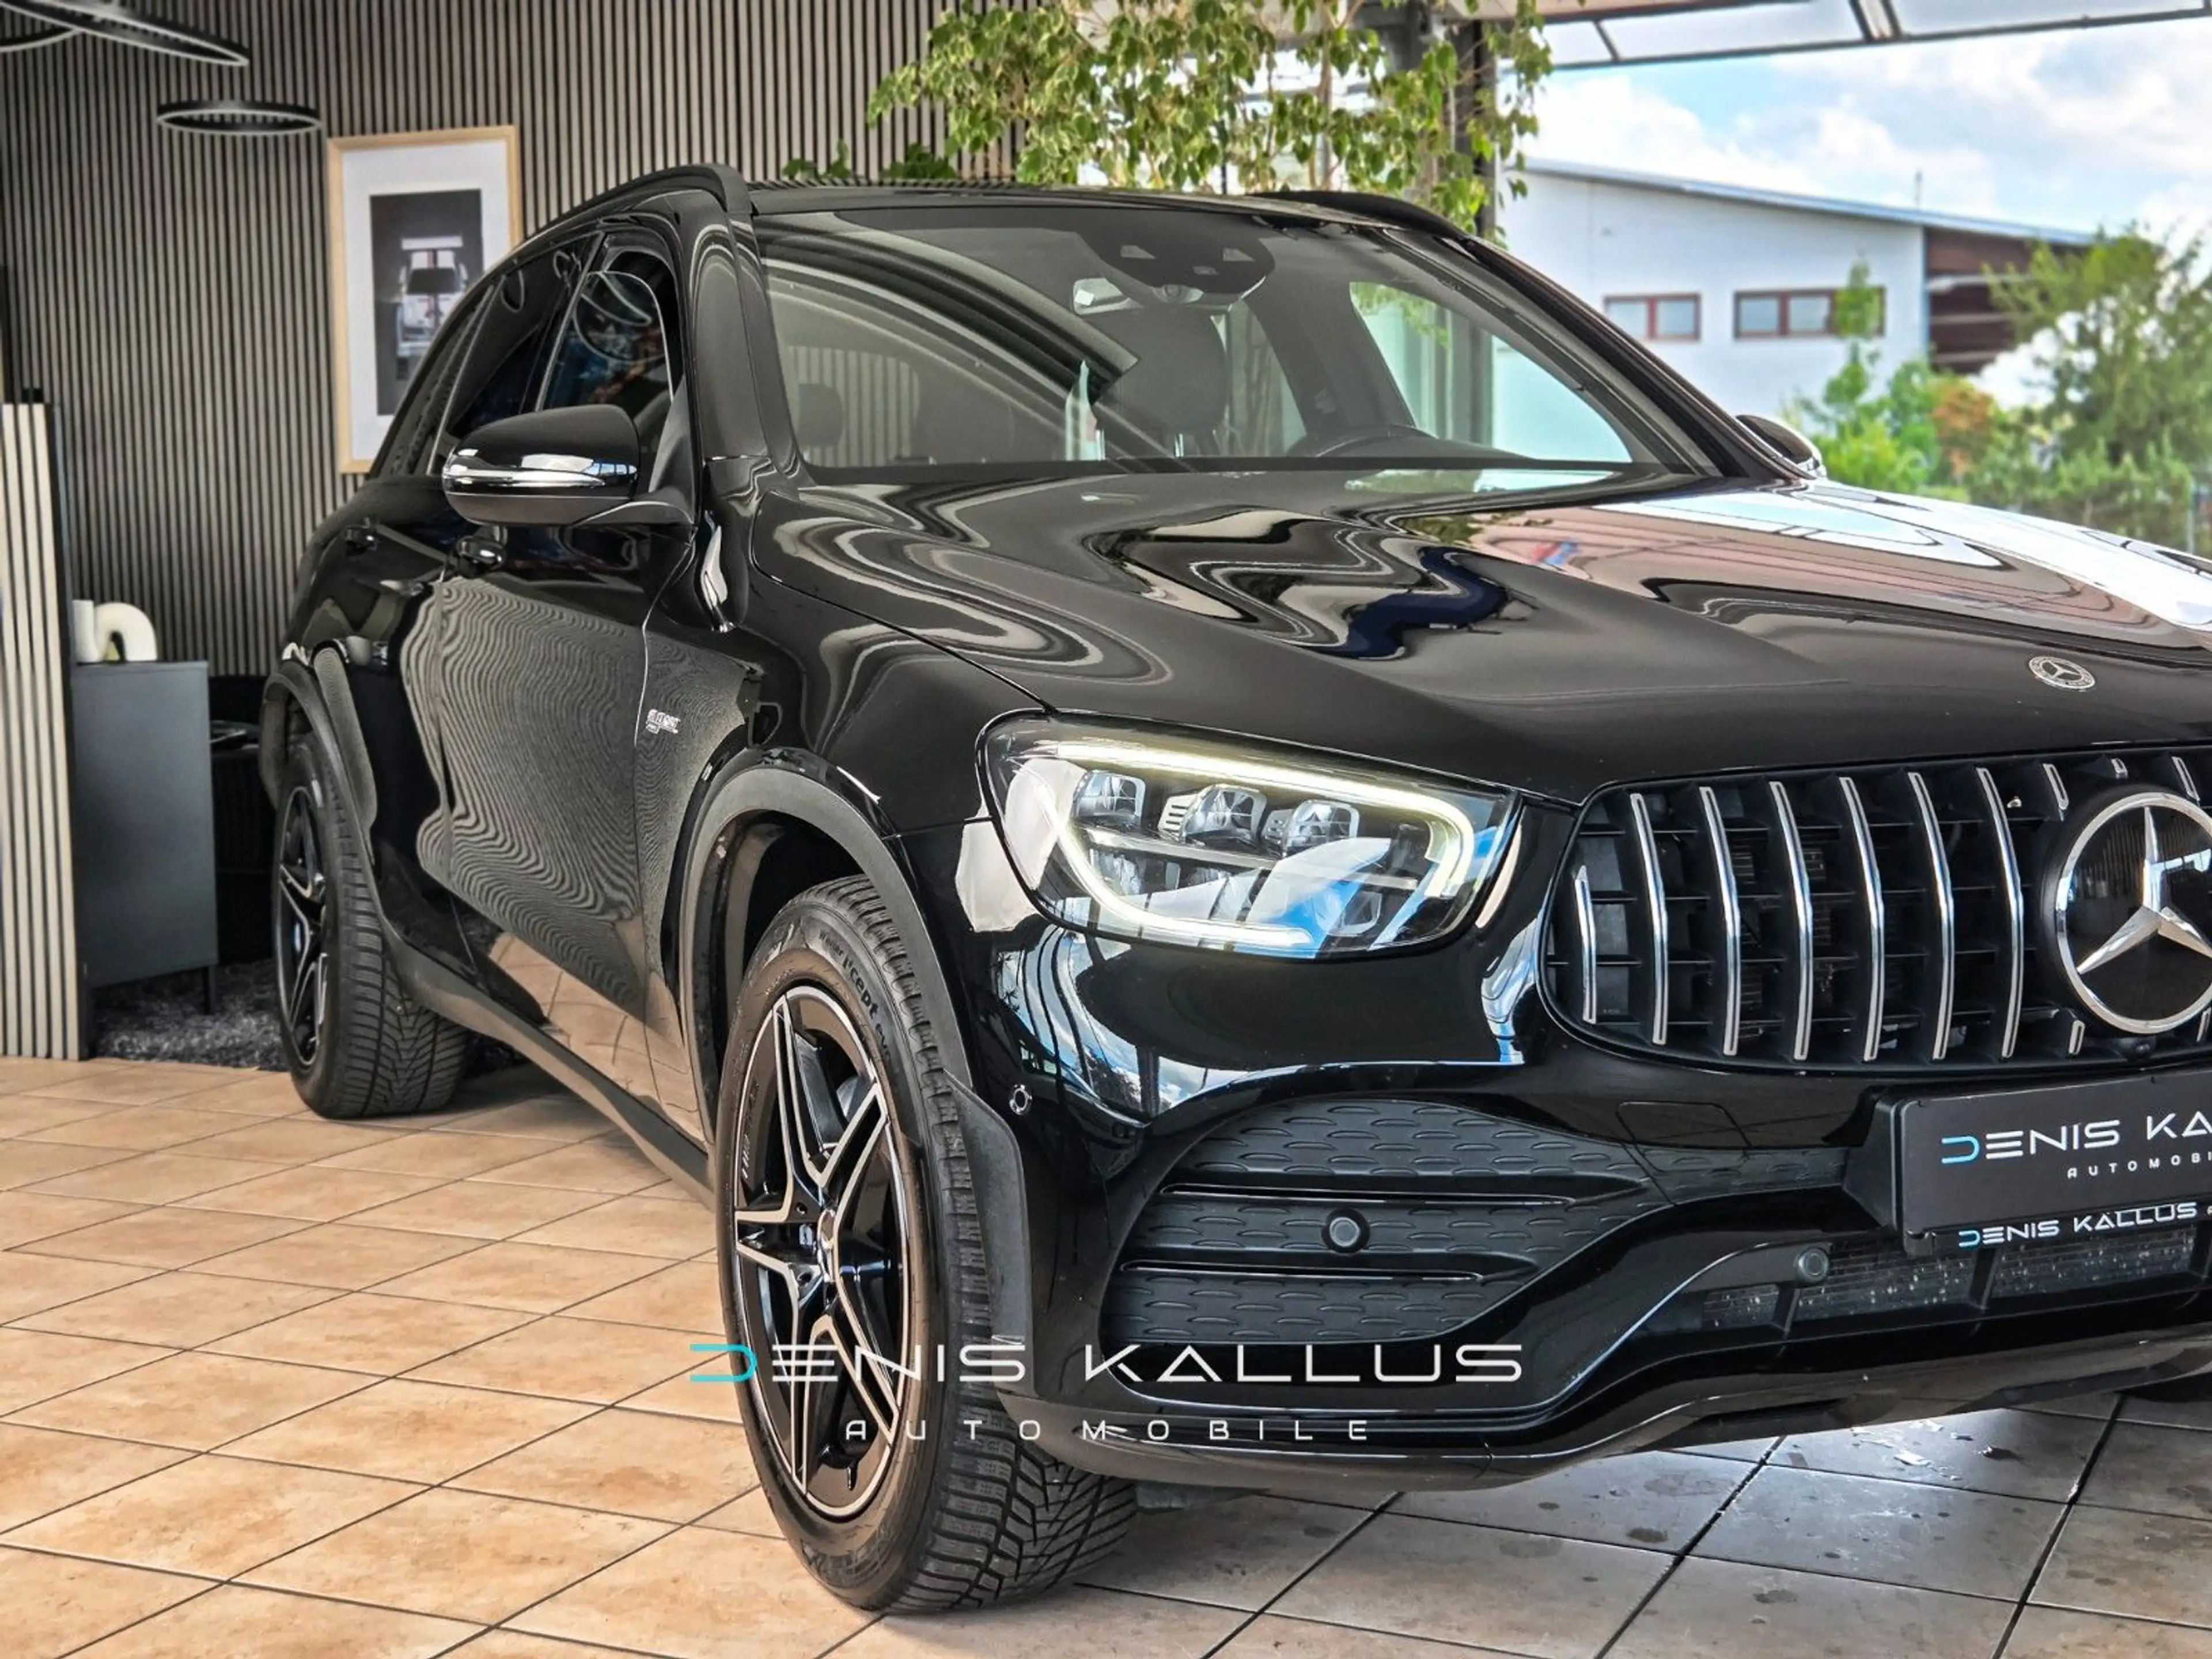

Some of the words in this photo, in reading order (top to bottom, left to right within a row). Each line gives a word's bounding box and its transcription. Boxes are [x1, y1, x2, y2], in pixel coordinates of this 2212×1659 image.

[1941, 1119, 2121, 1164] DENIS
[1959, 1219, 2061, 1247] DENIS
[2073, 1202, 2197, 1233] KALLUS
